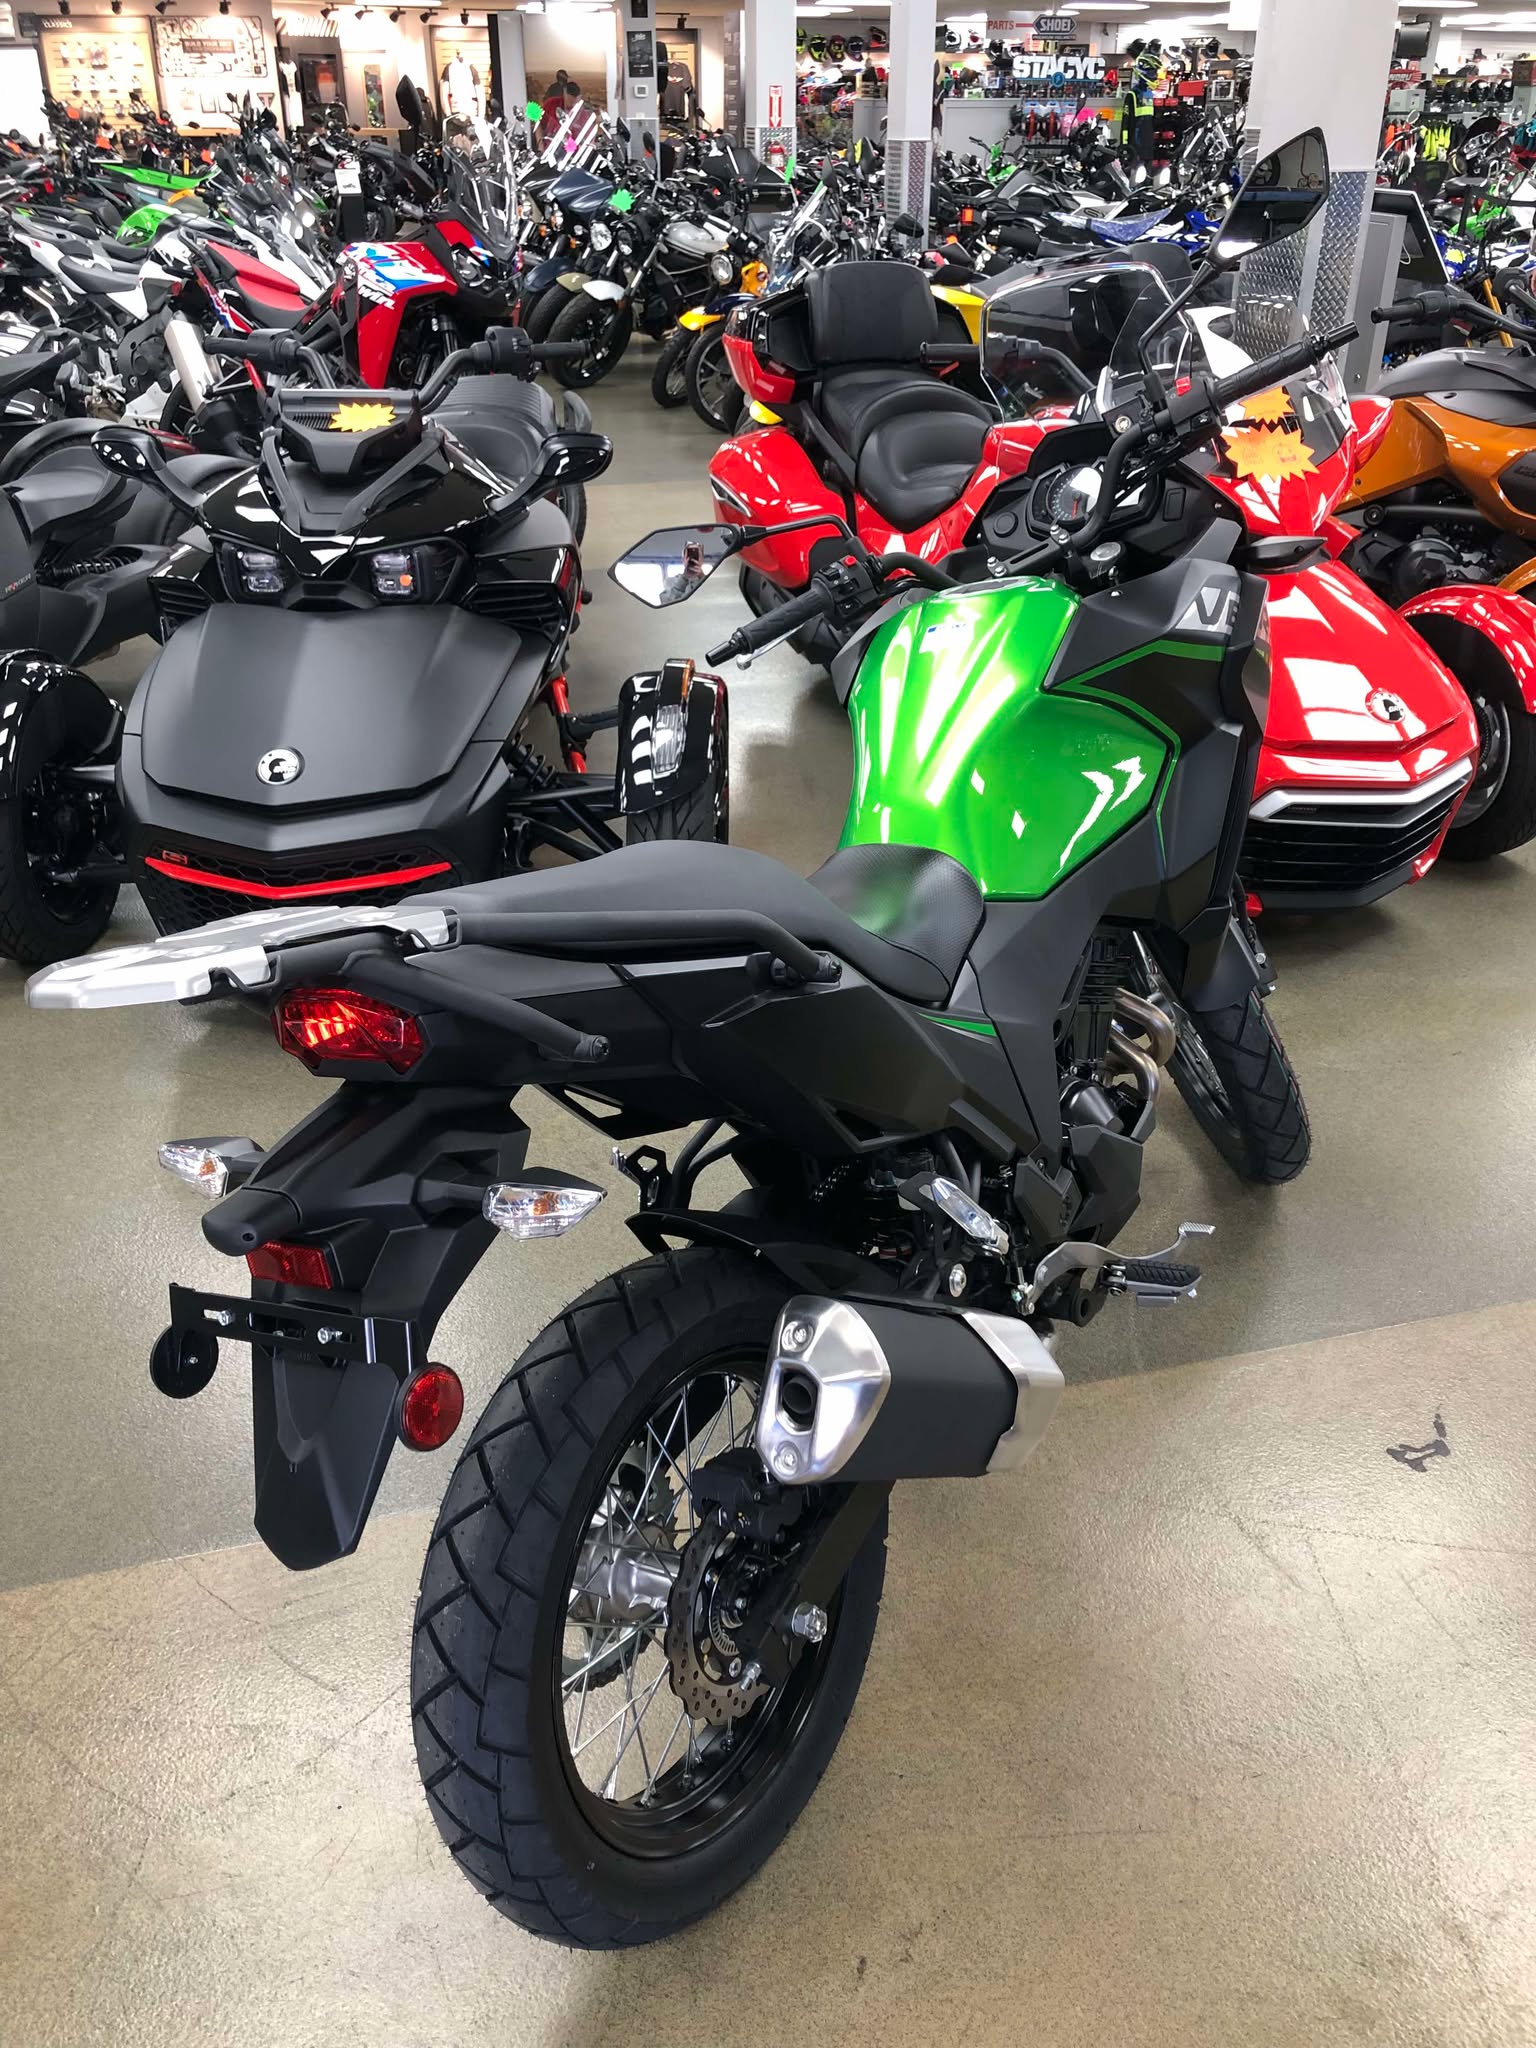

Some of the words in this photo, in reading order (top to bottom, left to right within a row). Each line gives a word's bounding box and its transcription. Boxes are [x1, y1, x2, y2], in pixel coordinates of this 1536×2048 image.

[987, 20, 1014, 30] PARTS
[1040, 16, 1071, 32] SHOEI
[1012, 55, 1106, 80] STACYC
[357, 285, 397, 310] win
